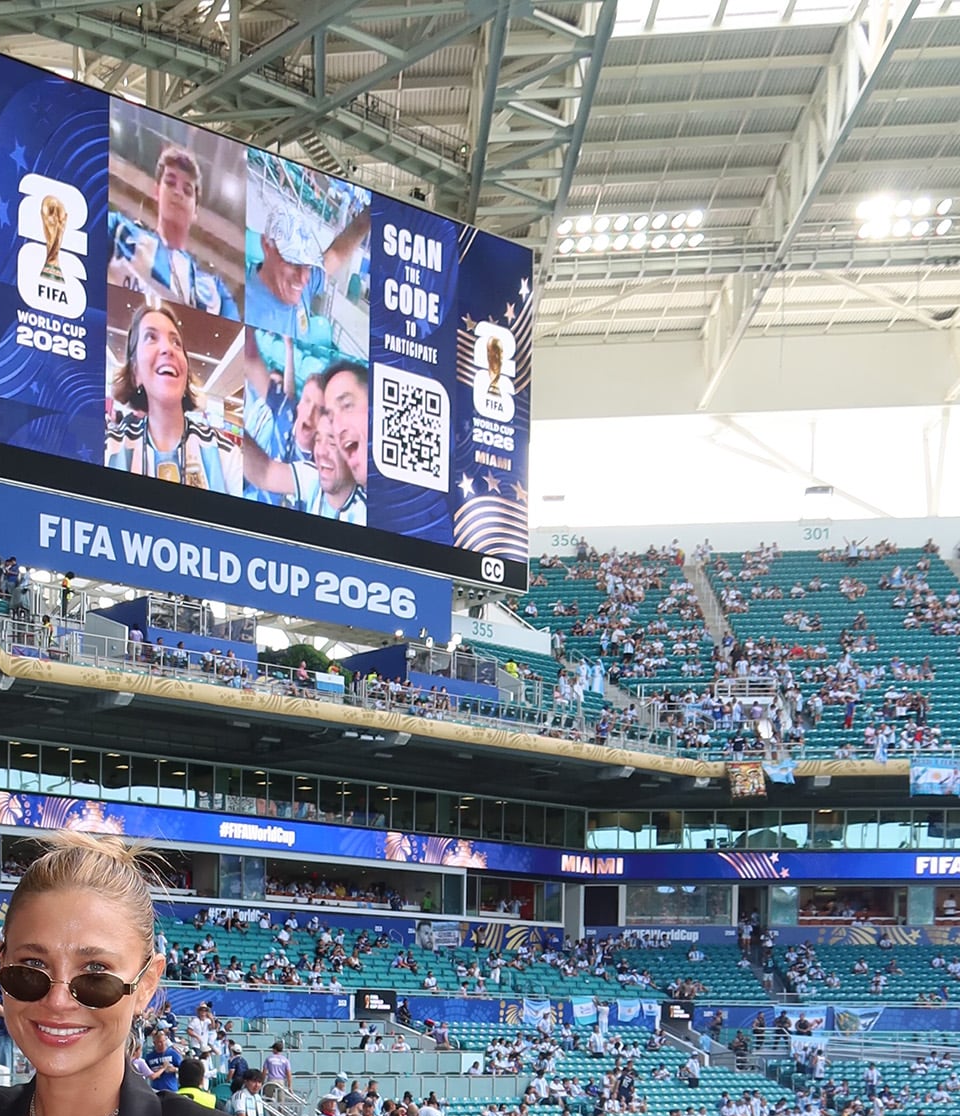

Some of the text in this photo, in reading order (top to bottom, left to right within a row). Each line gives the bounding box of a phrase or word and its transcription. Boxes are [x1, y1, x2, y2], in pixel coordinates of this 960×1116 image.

[383, 224, 442, 273] SCAN
[405, 265, 420, 285] THE
[38, 284, 69, 305] FIFA
[384, 278, 440, 324] CODE
[16, 309, 87, 339] WORLD CUP
[405, 320, 417, 338] TO
[16, 325, 87, 361] 2026
[384, 333, 438, 364] PARTICIPATE
[485, 399, 504, 412] FIFA
[473, 417, 515, 437] WORLD CUP
[472, 429, 515, 452] 2026
[475, 450, 512, 472] MIAMI
[551, 534, 579, 547] 356
[803, 527, 829, 540] 301
[40, 513, 417, 619] FIFA WORLD CUP 2026
[484, 561, 501, 579] CC
[472, 621, 493, 638] 355
[219, 821, 296, 847] #FIFAWorldCup
[561, 854, 624, 875] MIAMI
